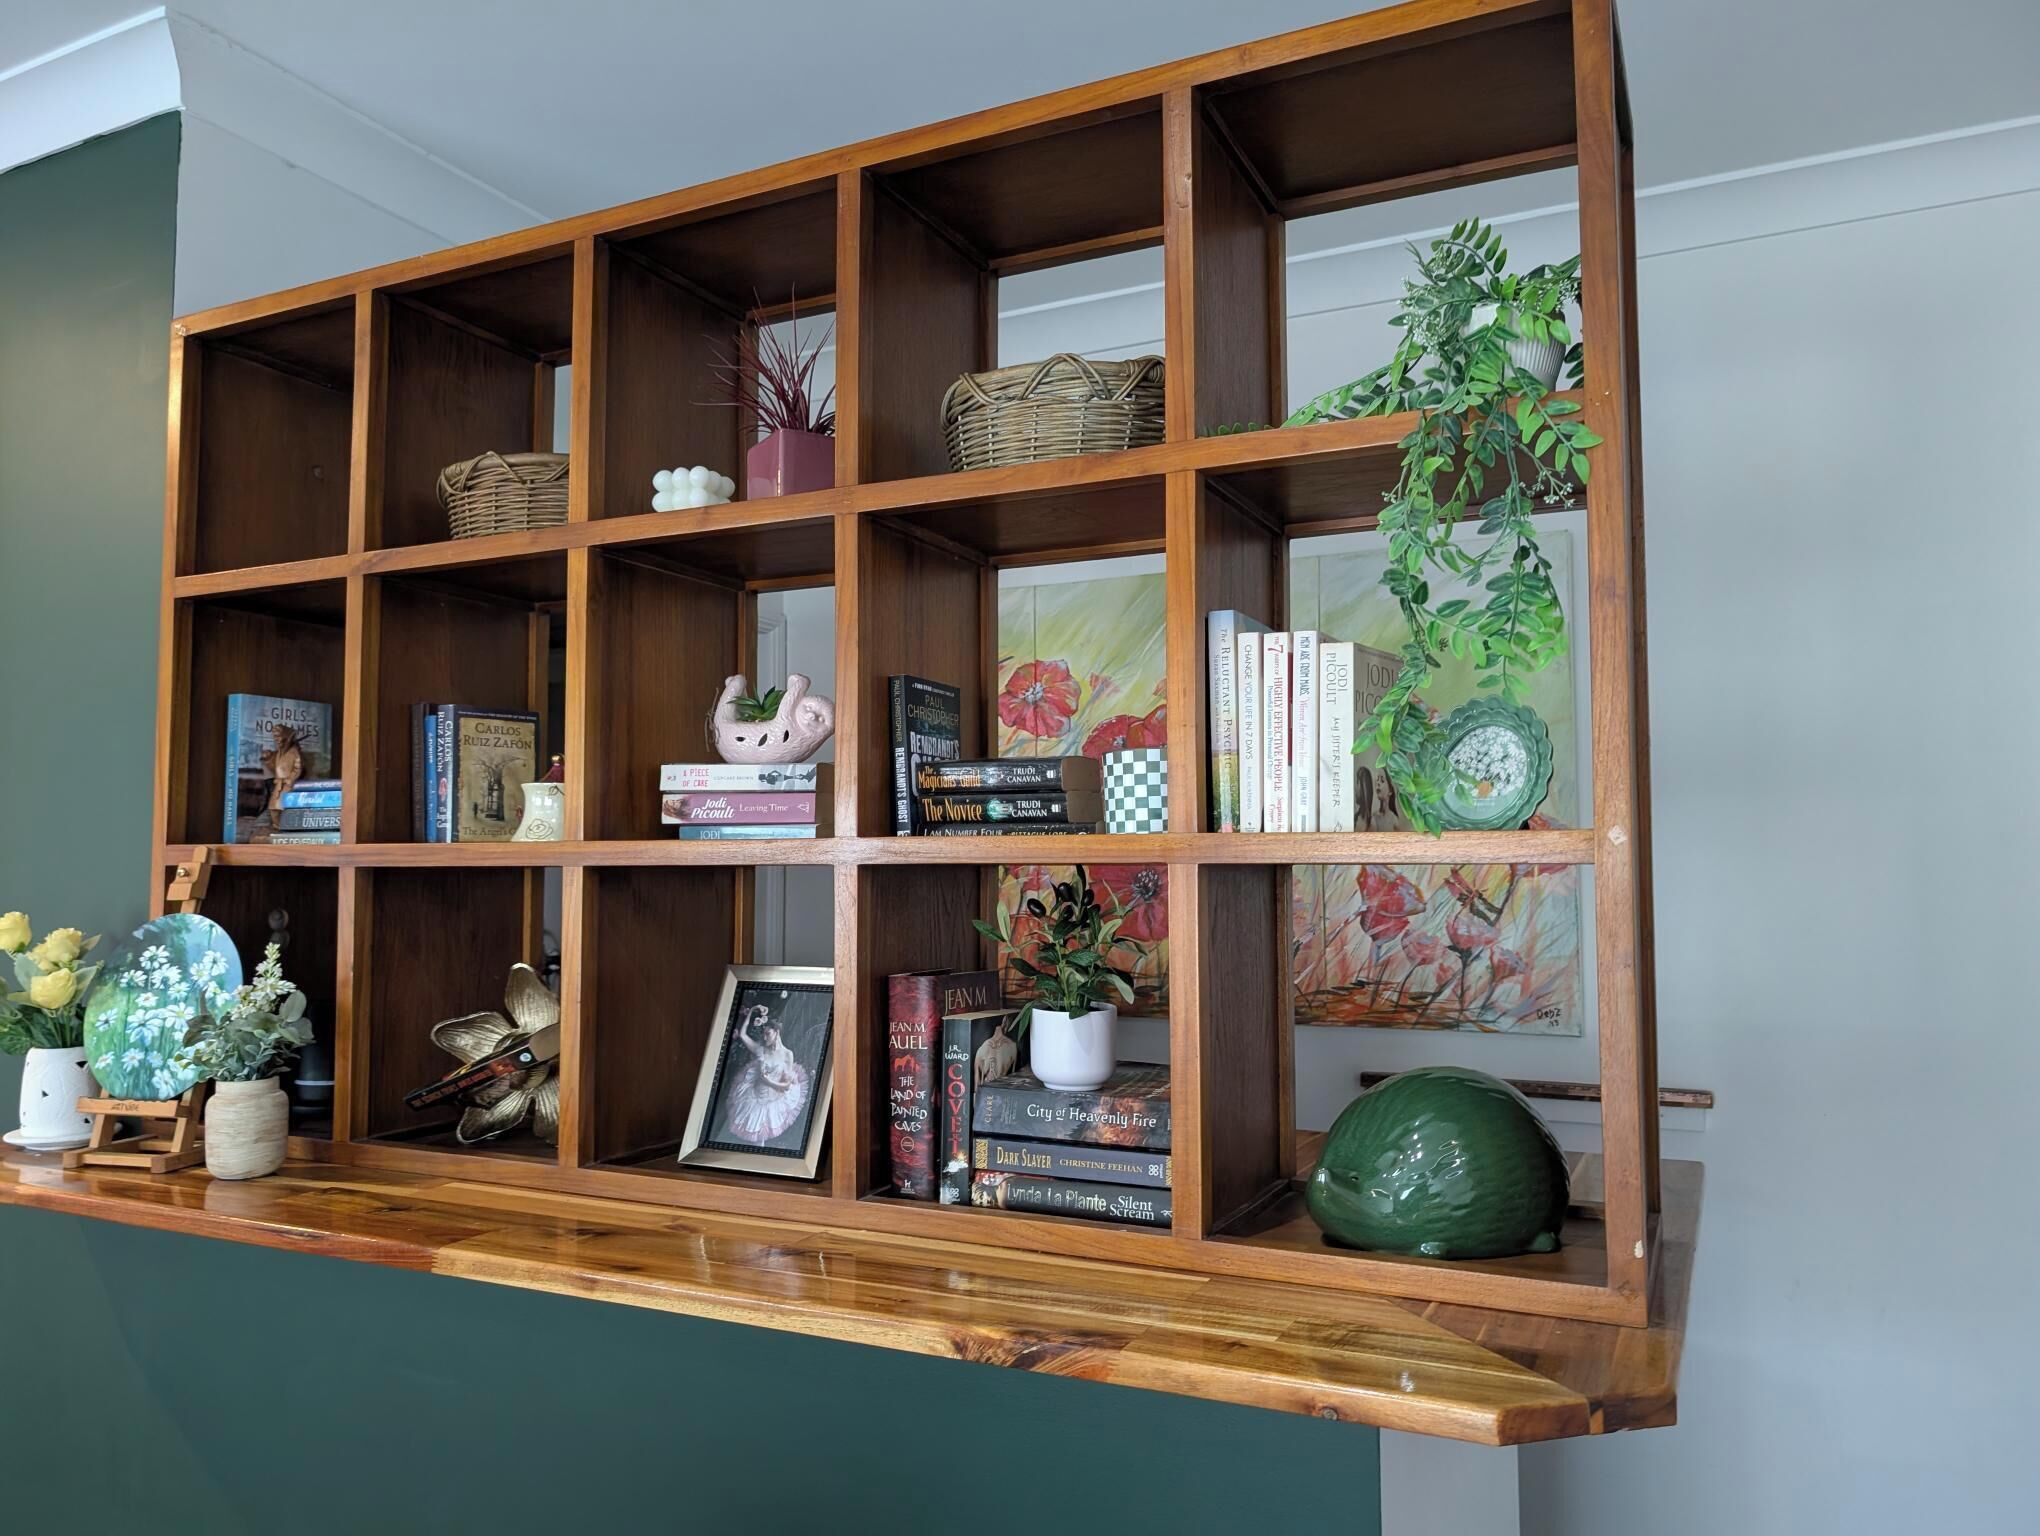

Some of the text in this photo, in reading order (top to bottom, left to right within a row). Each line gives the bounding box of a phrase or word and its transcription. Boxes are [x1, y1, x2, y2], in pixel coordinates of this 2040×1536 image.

[1268, 644, 1283, 654] 7
[1300, 636, 1310, 649] MEN
[1244, 644, 1252, 680] CHANGE
[1300, 650, 1310, 661] ARE
[1300, 662, 1310, 678] FROM
[1336, 663, 1348, 691] JODI
[1366, 662, 1394, 688] JODI
[1326, 652, 1337, 705] PICOULT
[1220, 628, 1233, 769] The RELUCTANT PSYCHIC
[1244, 681, 1253, 703] YOUR
[1273, 677, 1283, 709] HIGHLY
[925, 694, 944, 709] PAUL
[271, 706, 307, 722] GIRLS
[894, 698, 903, 742] CHRISTOPHER
[907, 703, 960, 727] CHRISTOPHER
[1245, 704, 1253, 720] LIFE
[256, 720, 273, 734] NO
[437, 711, 446, 736] RUIZ
[475, 722, 521, 736] CARLOS
[1245, 721, 1253, 730] IN
[444, 720, 454, 762] CARLOS
[463, 734, 532, 750] RUIZ ZAFÓN
[1273, 711, 1283, 757] EFFECTIVE
[910, 731, 960, 760] REMBRANDT'S
[689, 768, 710, 777] PIECE
[895, 747, 907, 798] REMBRANDT'S
[925, 765, 934, 774] The
[1013, 766, 1036, 775] TRUDI
[1274, 758, 1284, 792] PEOPLE
[693, 779, 709, 787] CAKE
[1007, 775, 1041, 784] CANAVAN
[1332, 772, 1341, 808] KEEPER
[702, 797, 728, 810] Jodi
[739, 803, 789, 813] Leaving Time
[897, 799, 908, 823] GHOST
[922, 797, 982, 821] The Novice
[1016, 800, 1041, 809] TRUDI
[690, 805, 735, 819] Picoult
[1011, 809, 1048, 817] CANAVAN
[464, 826, 478, 836] The
[700, 830, 720, 839] JODI
[944, 828, 978, 837] NUMBER
[981, 828, 1003, 837] FOUR
[944, 987, 971, 1014] JEAN
[890, 1022, 927, 1034] JEAN M.
[889, 1035, 928, 1050] AUEL
[945, 1052, 969, 1061] WARD
[898, 1076, 915, 1087] THE
[890, 1087, 927, 1102] LAND OF
[890, 1102, 928, 1120] PAINTED
[948, 1063, 965, 1153] COVET
[984, 1094, 994, 1124] CLARE
[1027, 1103, 1157, 1128] City of Heavenly Fire
[894, 1120, 921, 1132] CAVES
[996, 1146, 1020, 1166] DARK
[1022, 1148, 1052, 1169] SLAYER
[1059, 1158, 1106, 1170] CHRISTINE
[1108, 1160, 1143, 1173] FEEHAN
[1007, 1183, 1107, 1212] Lynda La Plante
[1117, 1195, 1153, 1211] Silent
[1110, 1203, 1155, 1221] Scream
